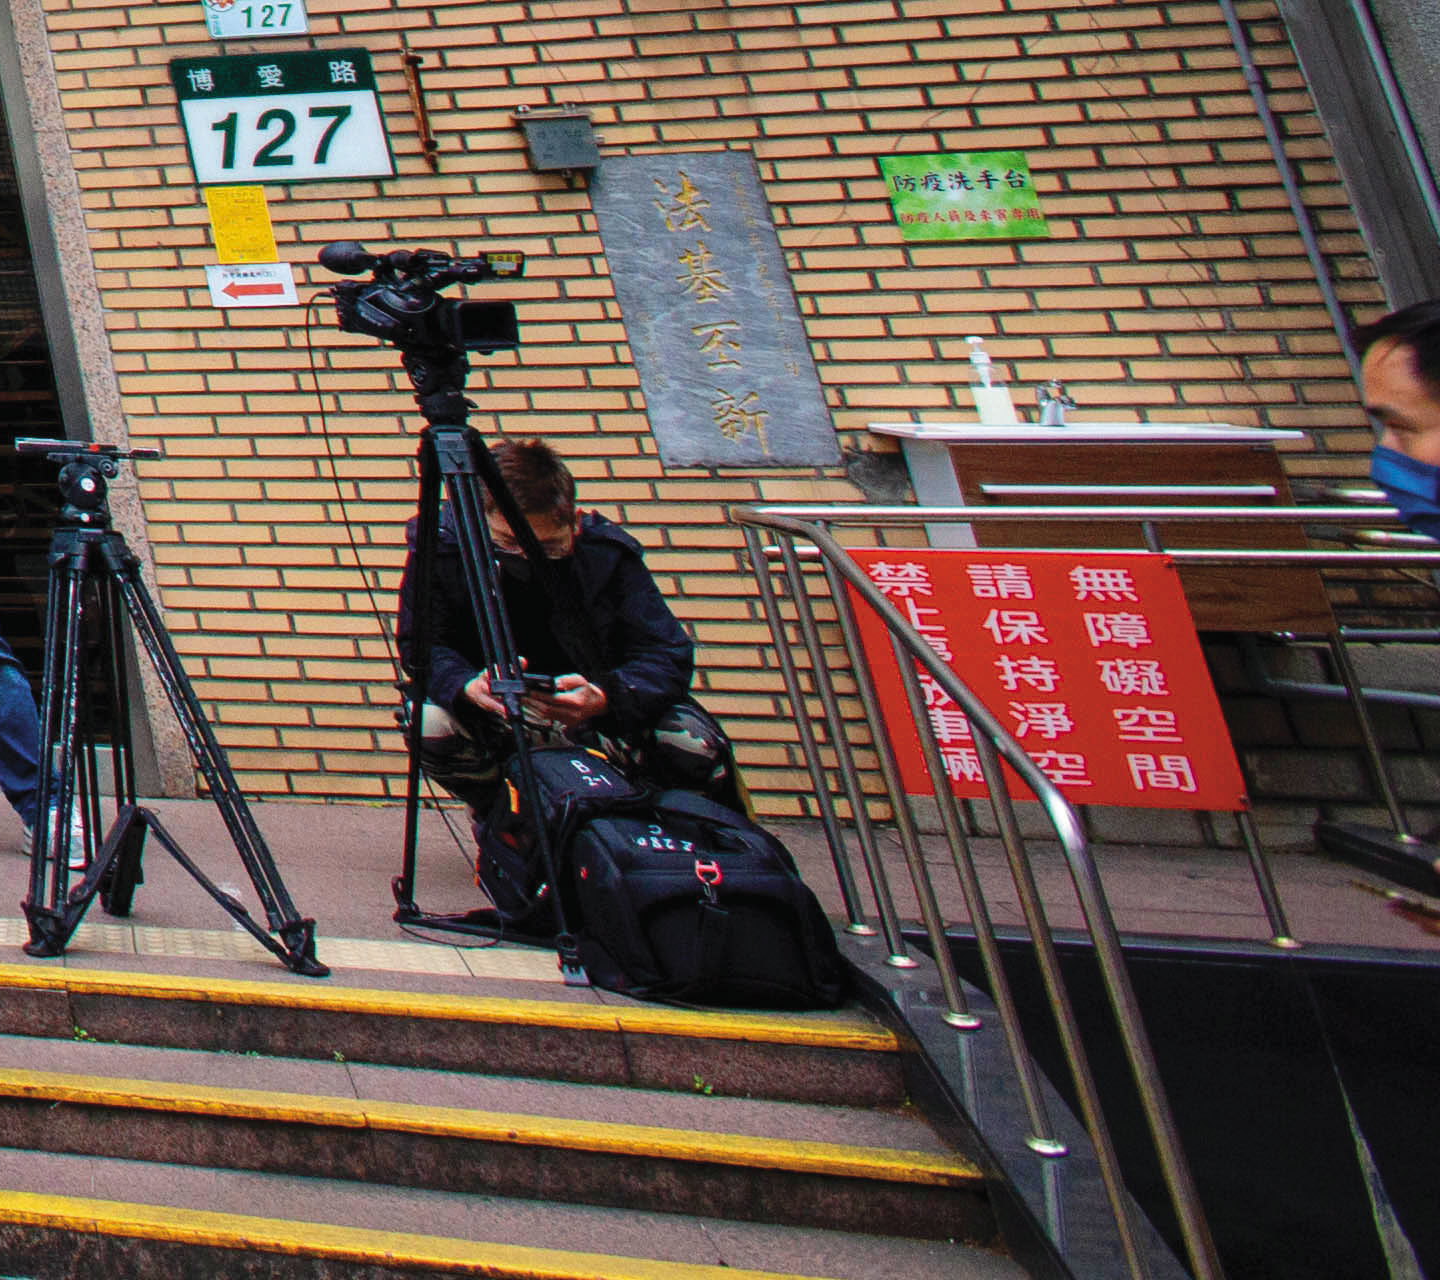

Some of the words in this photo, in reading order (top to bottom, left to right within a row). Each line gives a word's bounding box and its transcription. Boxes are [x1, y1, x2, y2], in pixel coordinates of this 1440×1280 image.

[241, 3, 293, 28] 127
[186, 59, 357, 93] 博愛路
[211, 105, 352, 170] 127
[891, 167, 1027, 193] 防疫洗手台
[966, 563, 1093, 787] 請保持淨空
[1068, 565, 1198, 793] 無障礙空間
[570, 758, 592, 775] B
